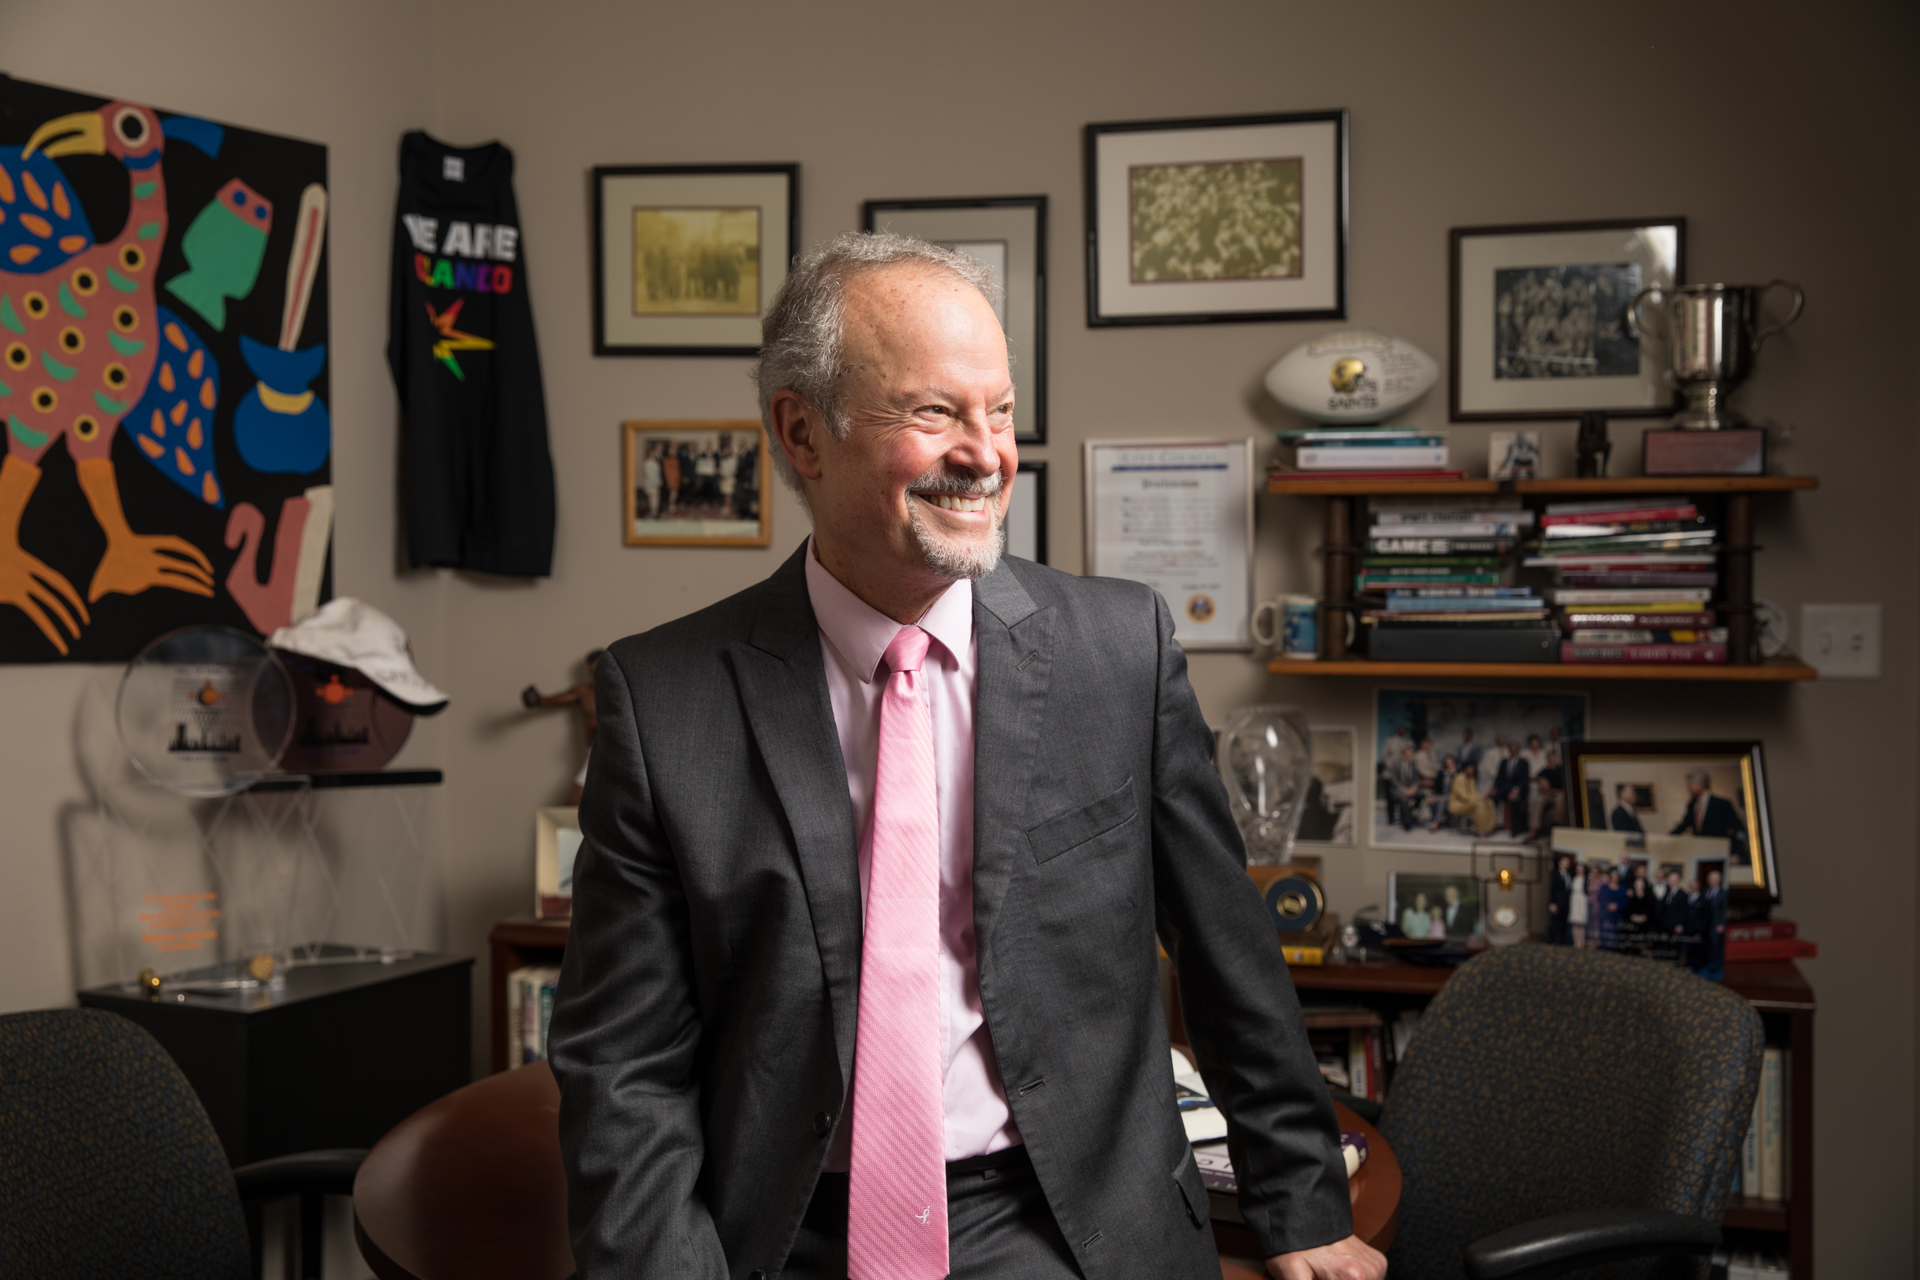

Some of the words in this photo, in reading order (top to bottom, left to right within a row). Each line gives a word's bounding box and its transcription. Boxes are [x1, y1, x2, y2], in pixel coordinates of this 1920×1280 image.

[441, 220, 519, 263] ARE
[1328, 395, 1378, 410] SAINTS
[1375, 539, 1428, 555] GAME
